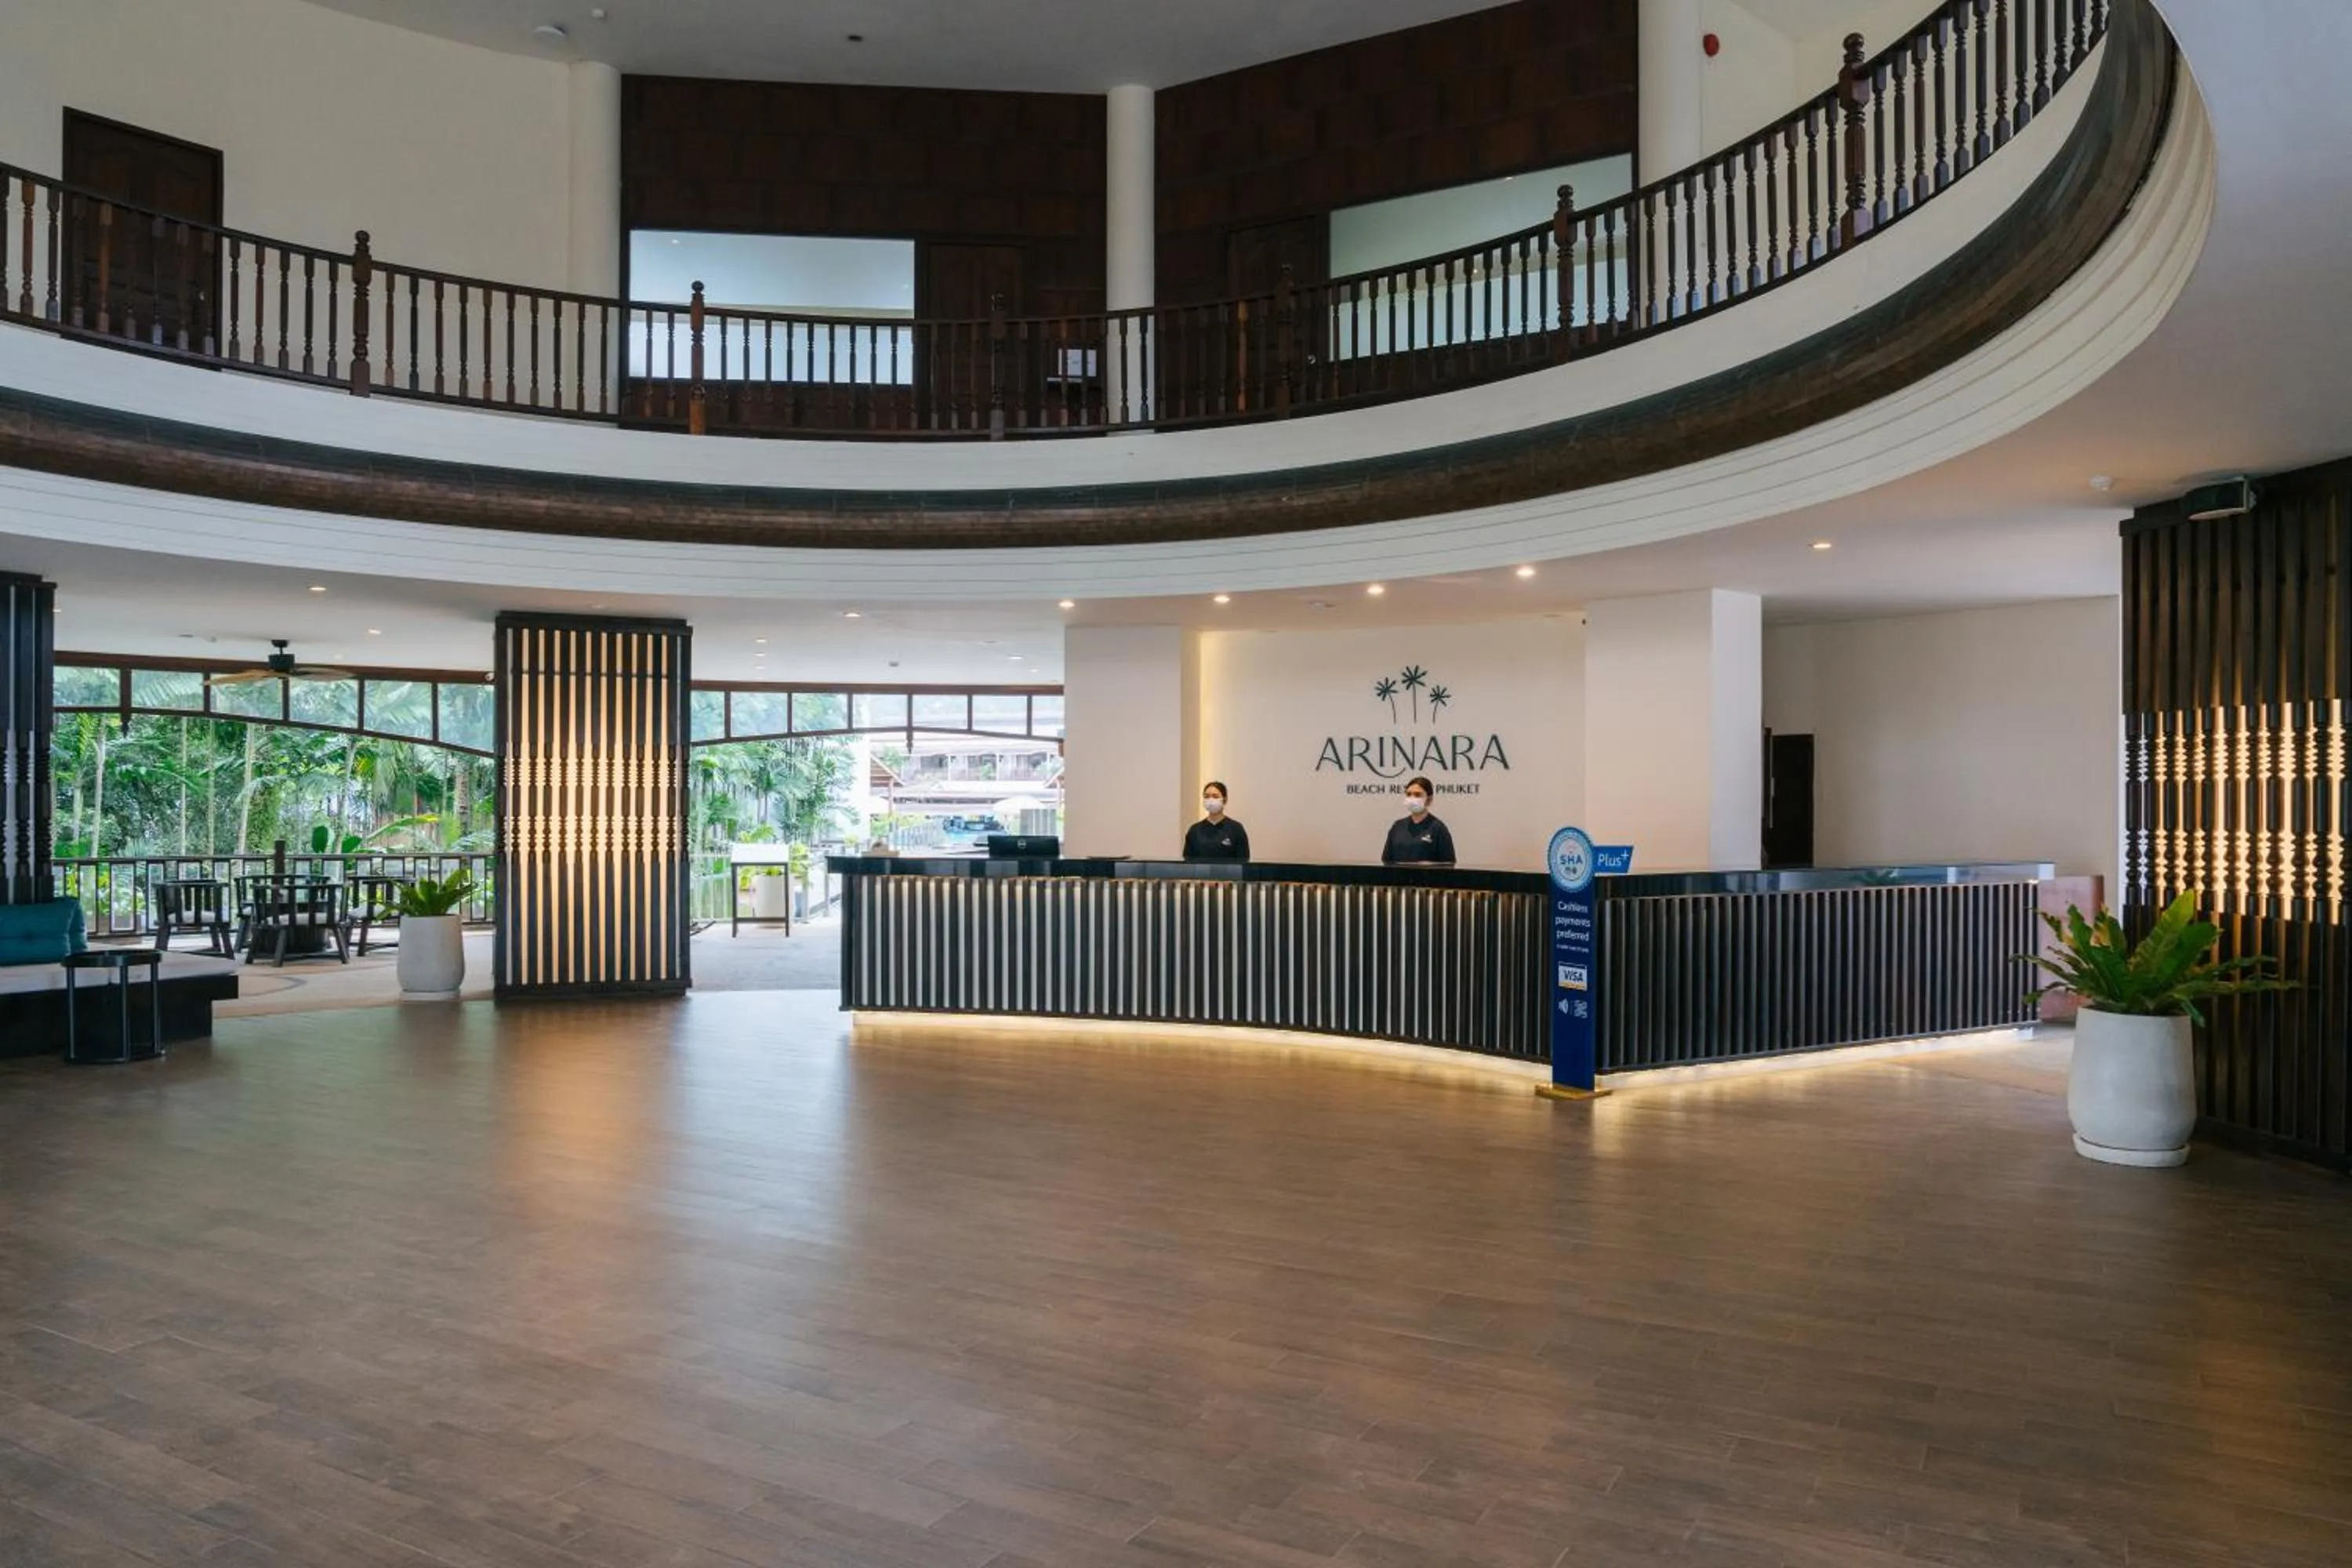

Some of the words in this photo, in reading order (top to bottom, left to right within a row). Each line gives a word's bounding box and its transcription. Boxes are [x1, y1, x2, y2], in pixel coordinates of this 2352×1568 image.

[1315, 734, 1510, 779] ARINARA
[1346, 785, 1385, 794] BEACH
[1436, 784, 1479, 793] PHUKET
[1560, 854, 1583, 865] SHA
